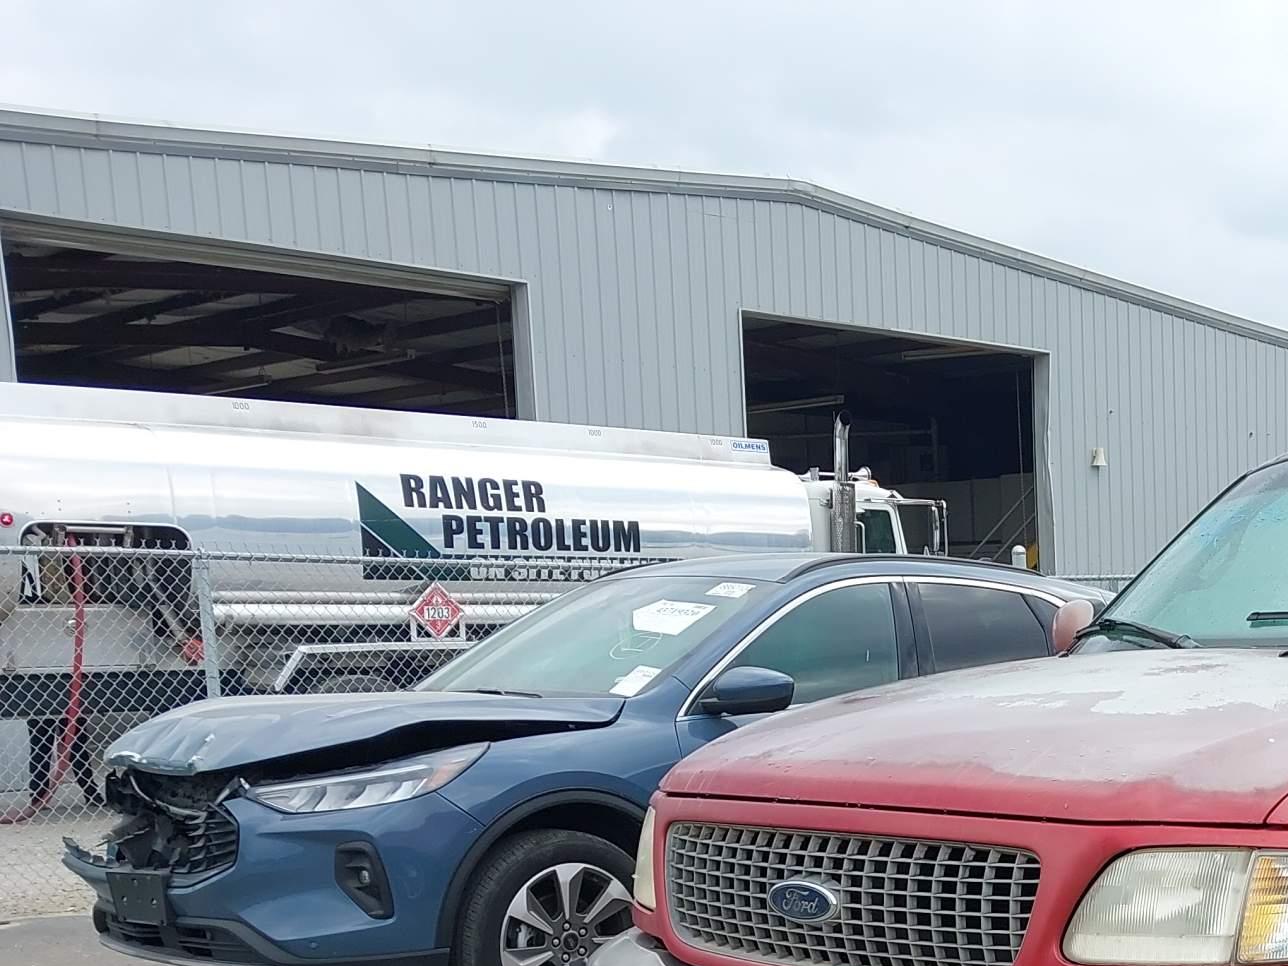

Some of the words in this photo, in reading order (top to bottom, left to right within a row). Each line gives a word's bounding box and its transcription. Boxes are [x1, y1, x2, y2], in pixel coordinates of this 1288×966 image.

[232, 401, 250, 410] 1000
[471, 420, 487, 429] 1500
[732, 441, 766, 451] OILMENS
[399, 473, 546, 513] RANGER
[442, 514, 641, 553] PETROLEUM
[426, 606, 450, 619] 1203
[782, 888, 819, 914] Ford
